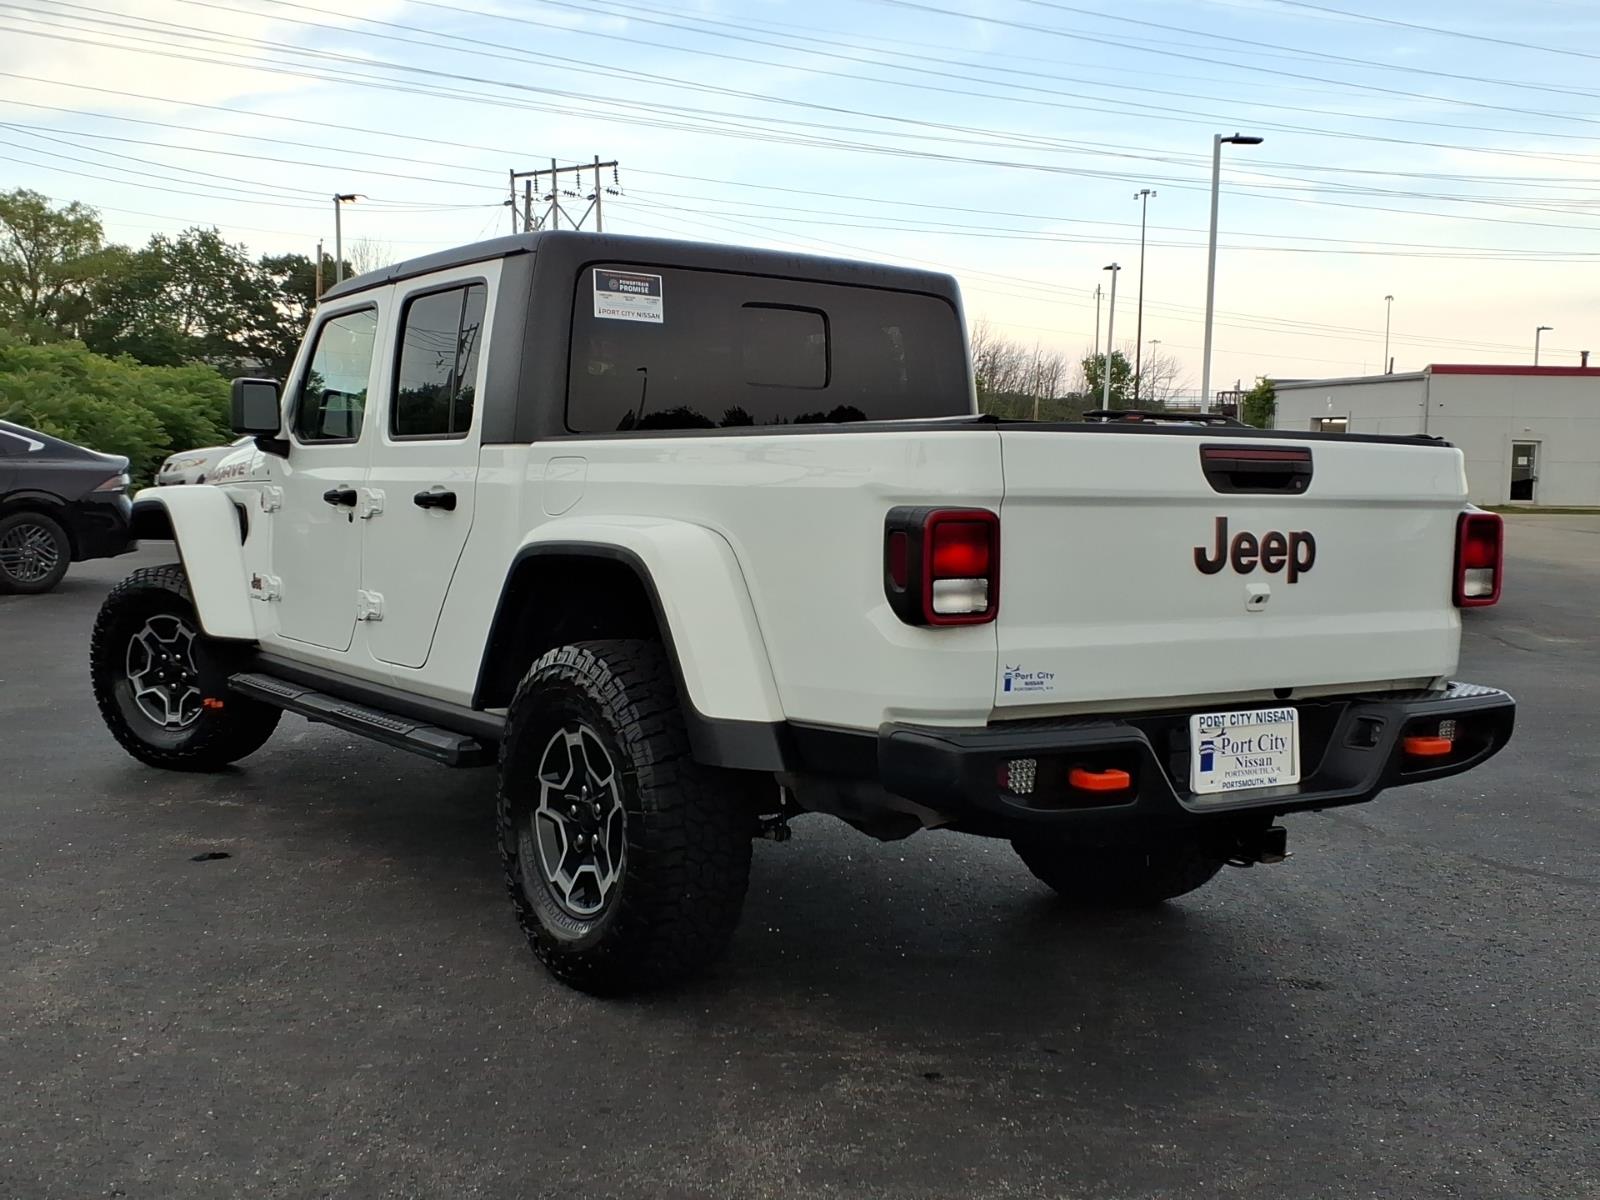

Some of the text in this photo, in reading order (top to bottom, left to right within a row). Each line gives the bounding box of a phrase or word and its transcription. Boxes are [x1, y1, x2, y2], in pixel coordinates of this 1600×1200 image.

[619, 279, 649, 287] POWERTRAIN
[619, 285, 649, 294] PROMISE
[1194, 517, 1316, 584] Jeep
[1015, 671, 1055, 680] Port City
[1200, 709, 1294, 727] PORT CITY NISSAN
[1222, 733, 1286, 754] Port City
[1235, 756, 1273, 769] Nissan
